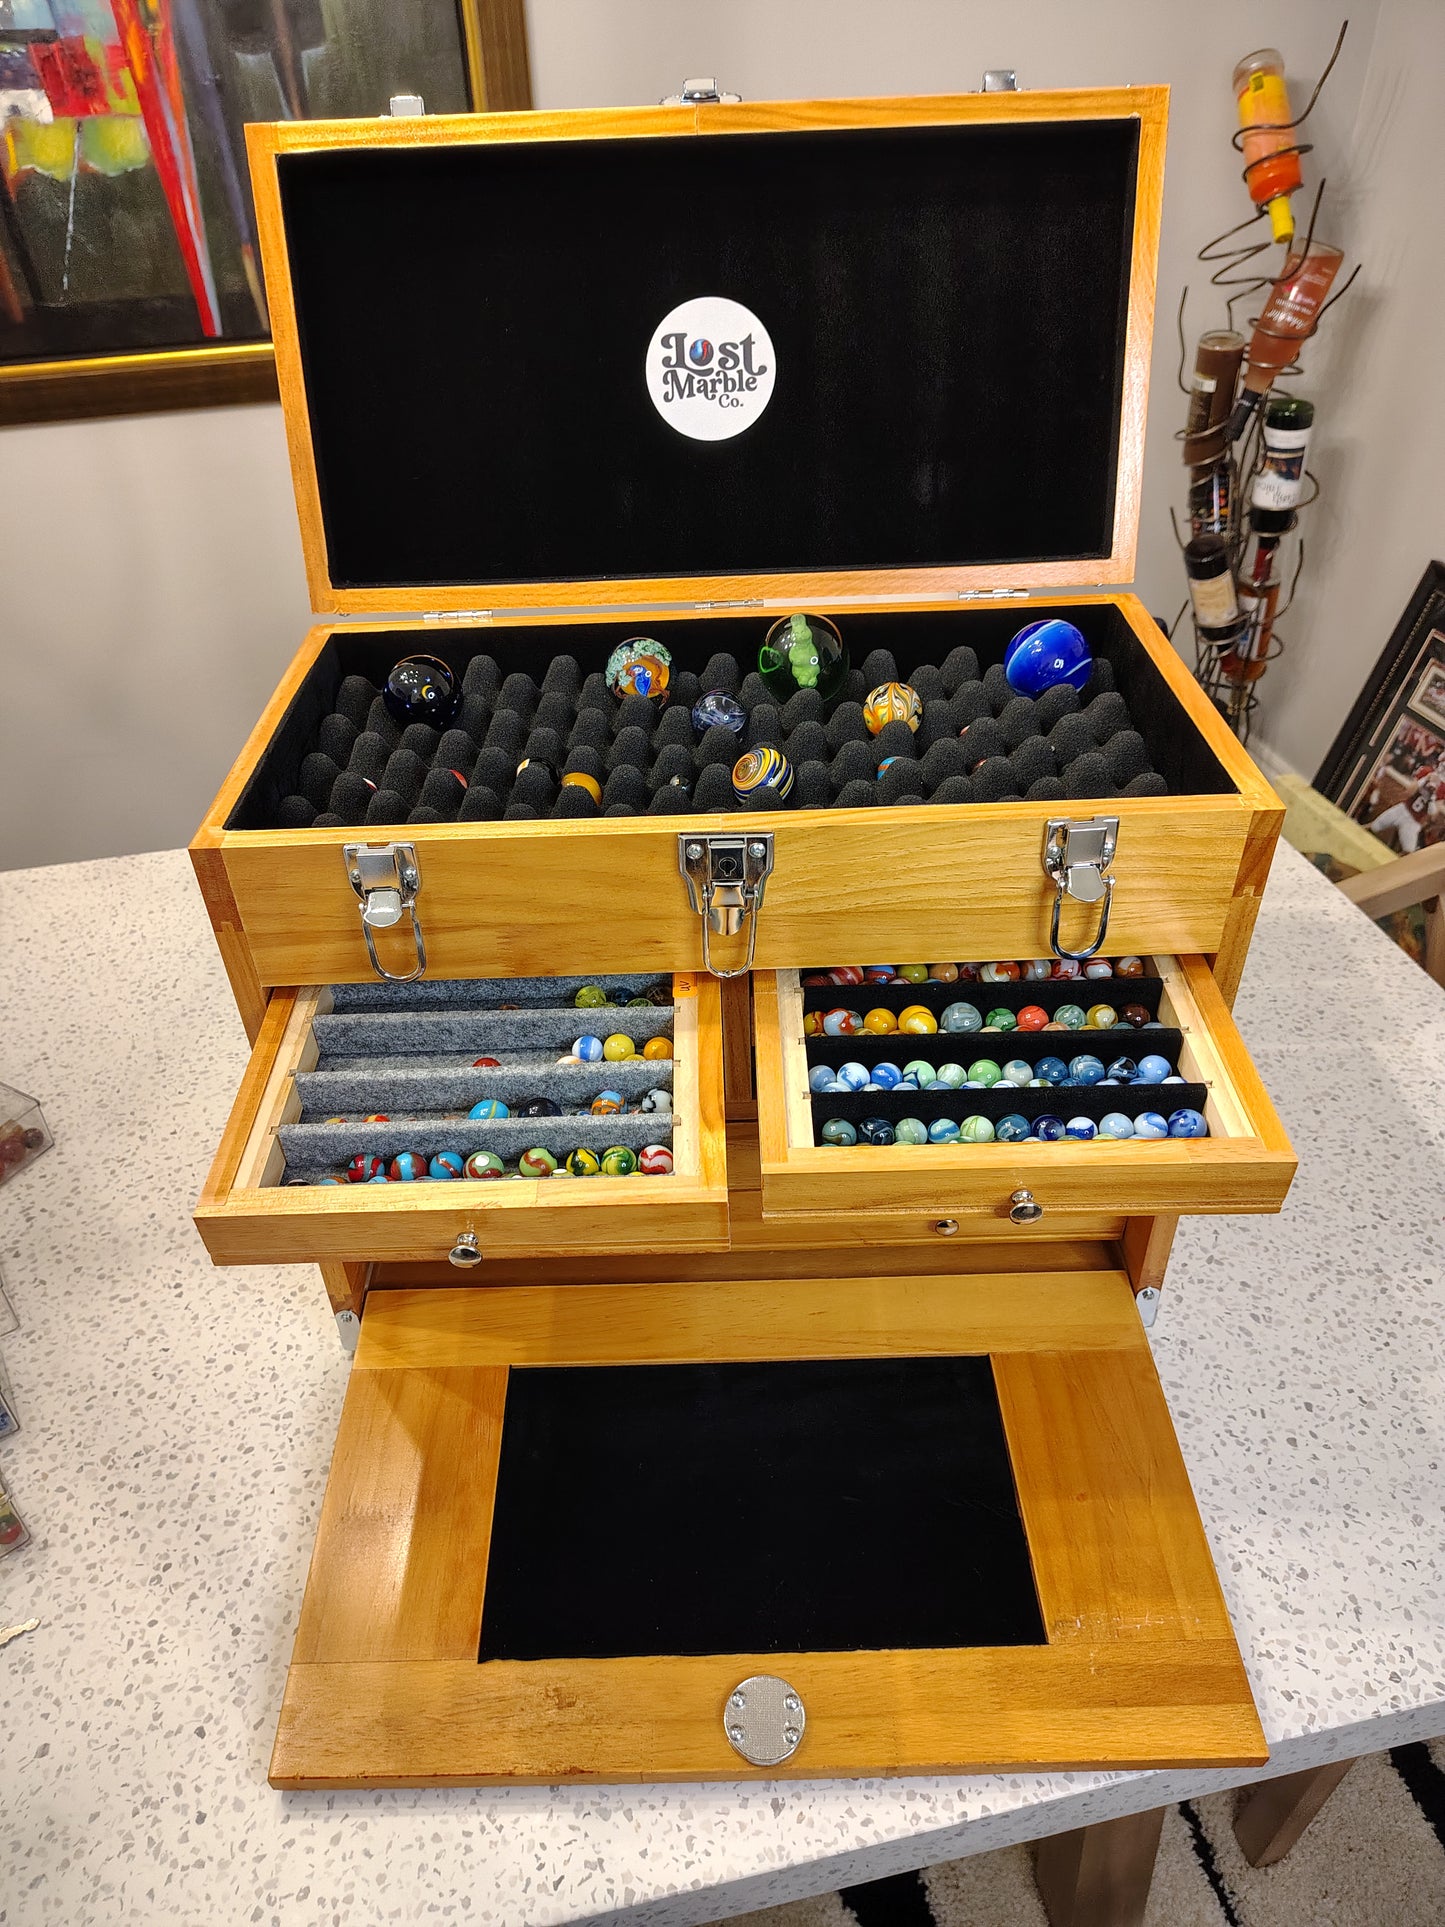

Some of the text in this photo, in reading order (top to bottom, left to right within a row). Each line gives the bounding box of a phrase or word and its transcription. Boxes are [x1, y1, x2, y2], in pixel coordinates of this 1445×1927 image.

[661, 332, 767, 377] Lost
[662, 369, 758, 403] Marble
[718, 394, 744, 408] Co.
